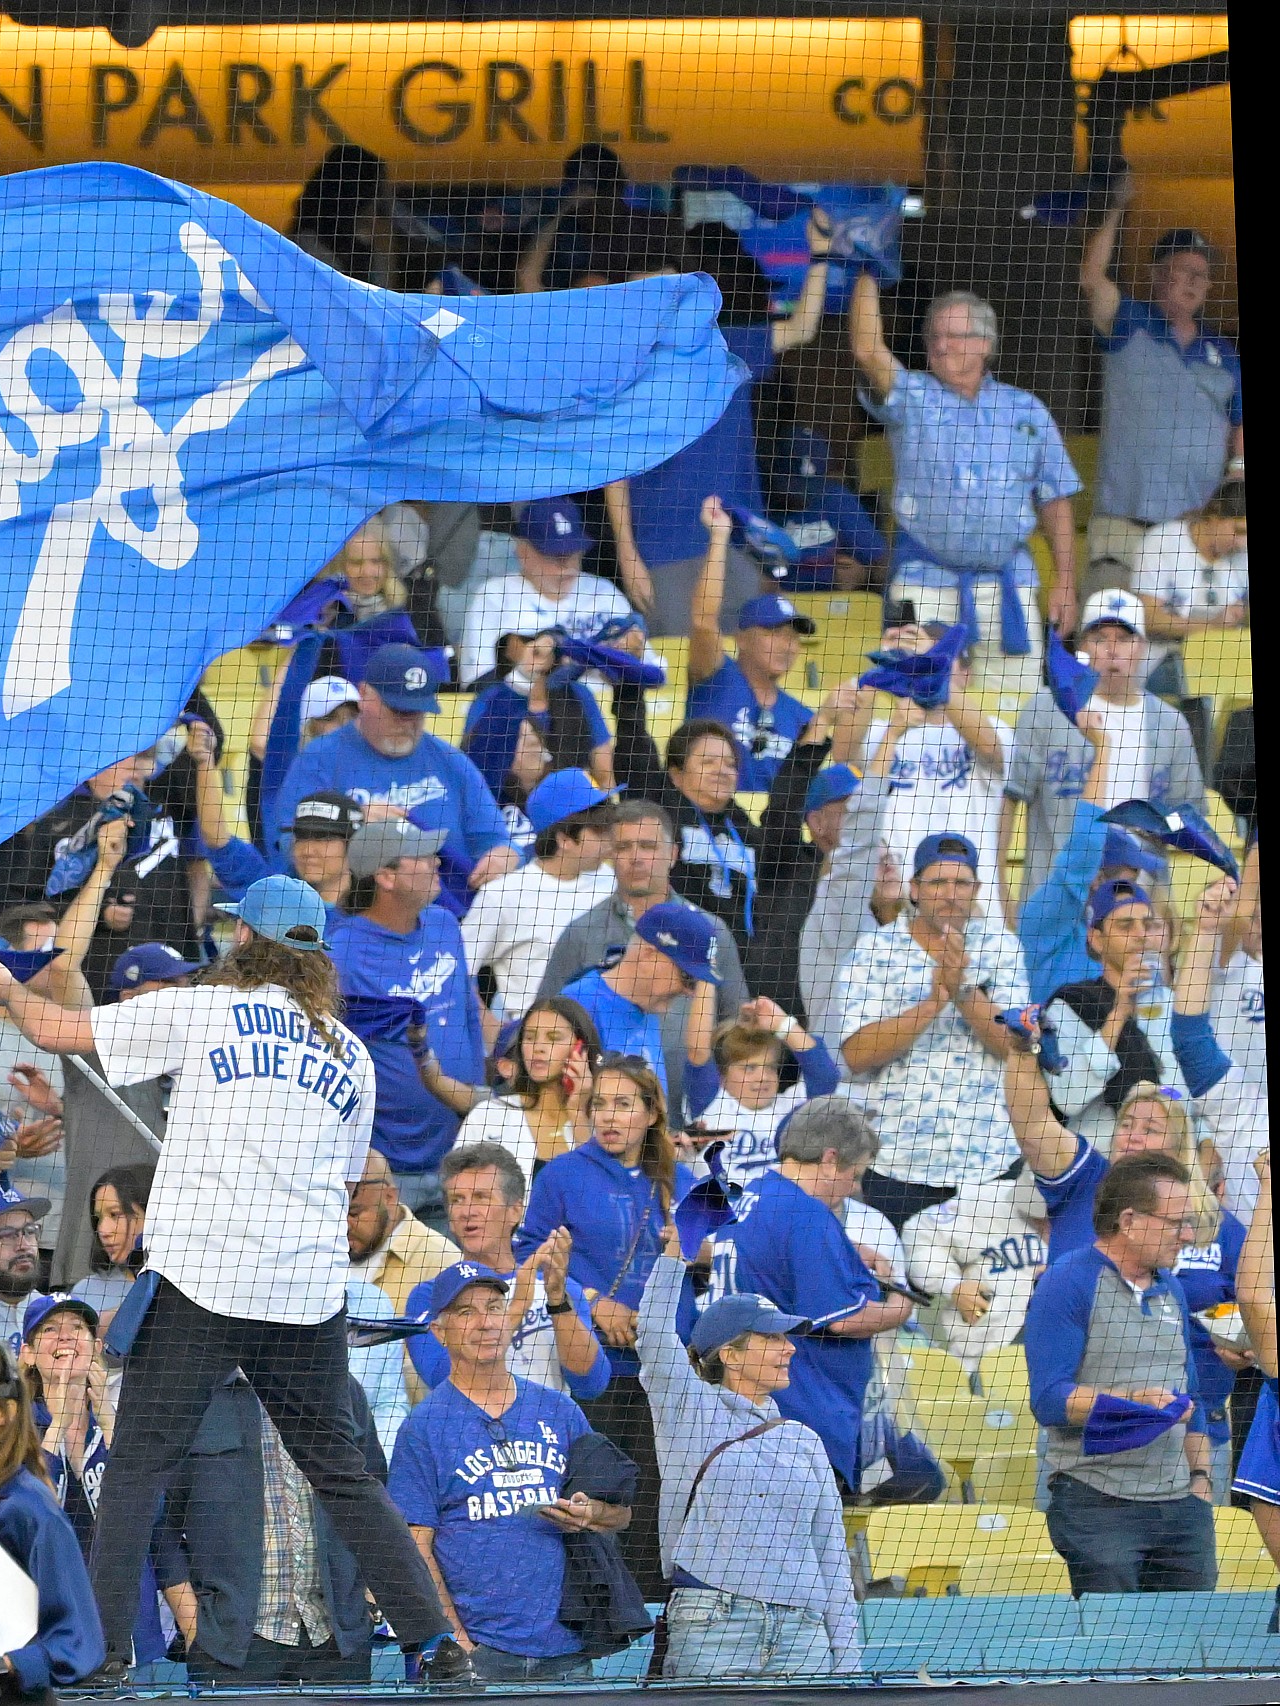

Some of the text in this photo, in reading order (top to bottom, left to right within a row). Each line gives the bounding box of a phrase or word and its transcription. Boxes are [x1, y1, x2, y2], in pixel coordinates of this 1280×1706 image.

[90, 60, 352, 149] PARK
[391, 59, 671, 144] GRILL
[209, 1042, 361, 1124] BLUE CREW
[455, 1263, 479, 1281] LA
[537, 1420, 560, 1445] LA
[455, 1448, 494, 1485] LOS
